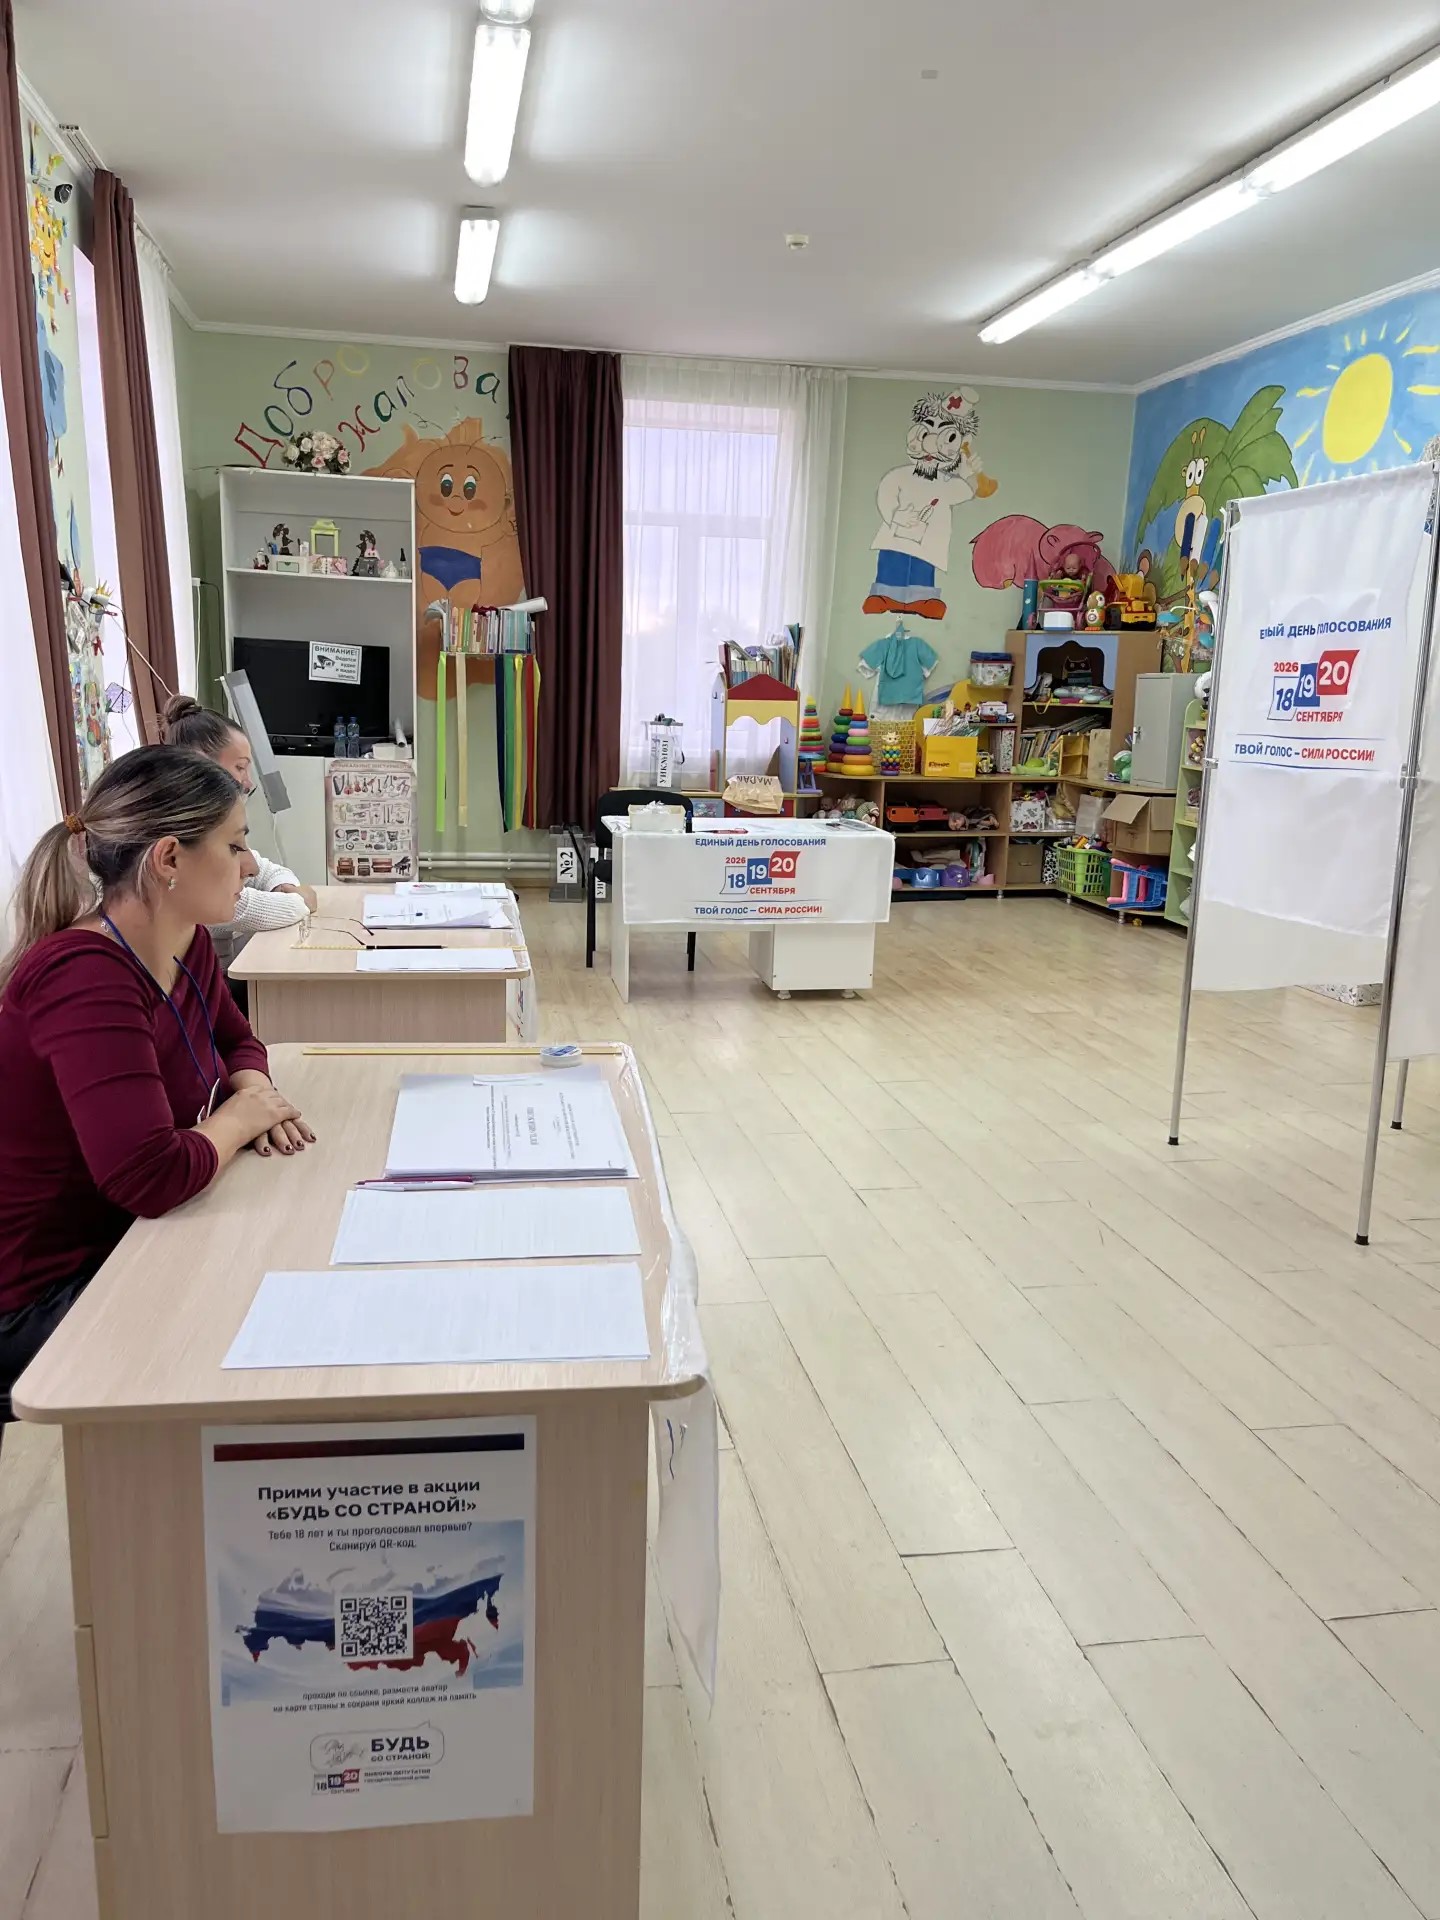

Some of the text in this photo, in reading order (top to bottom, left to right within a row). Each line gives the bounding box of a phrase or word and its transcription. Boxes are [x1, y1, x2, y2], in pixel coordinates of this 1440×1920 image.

[1287, 624, 1316, 638] ДЕНЬ
[1273, 661, 1299, 673] 2026
[1276, 660, 1350, 711] 18 19 20
[1296, 711, 1344, 722] СЕНТЯБРЯ
[1234, 742, 1263, 755] ТВОЙ
[1264, 744, 1293, 757] ГОЛОС
[1301, 747, 1325, 759] СИЛА
[1325, 748, 1375, 762] РОССИИ!
[695, 837, 826, 847] ЕДИНЫЙ ДЕНЬ ГОЛОСОВАНИЯ
[560, 851, 574, 878] №2
[727, 857, 795, 889] 18 19 20
[749, 887, 796, 895] СЕНТЯБРЯ
[694, 905, 719, 914] ТВОЙ
[758, 906, 782, 914] СИЛА
[784, 906, 822, 914] РОССИИ!
[258, 1481, 480, 1503] Прими участие в акции
[266, 1496, 477, 1522] «БУДЬ СО СТРАНОЙ!»
[268, 1521, 473, 1540] Тебе 18 лет и ты проголосовал впервые?
[329, 1540, 377, 1552] Сканируй
[371, 1736, 430, 1753] БУДЬ
[316, 1782, 328, 1791] 18
[343, 1771, 358, 1781] 20
